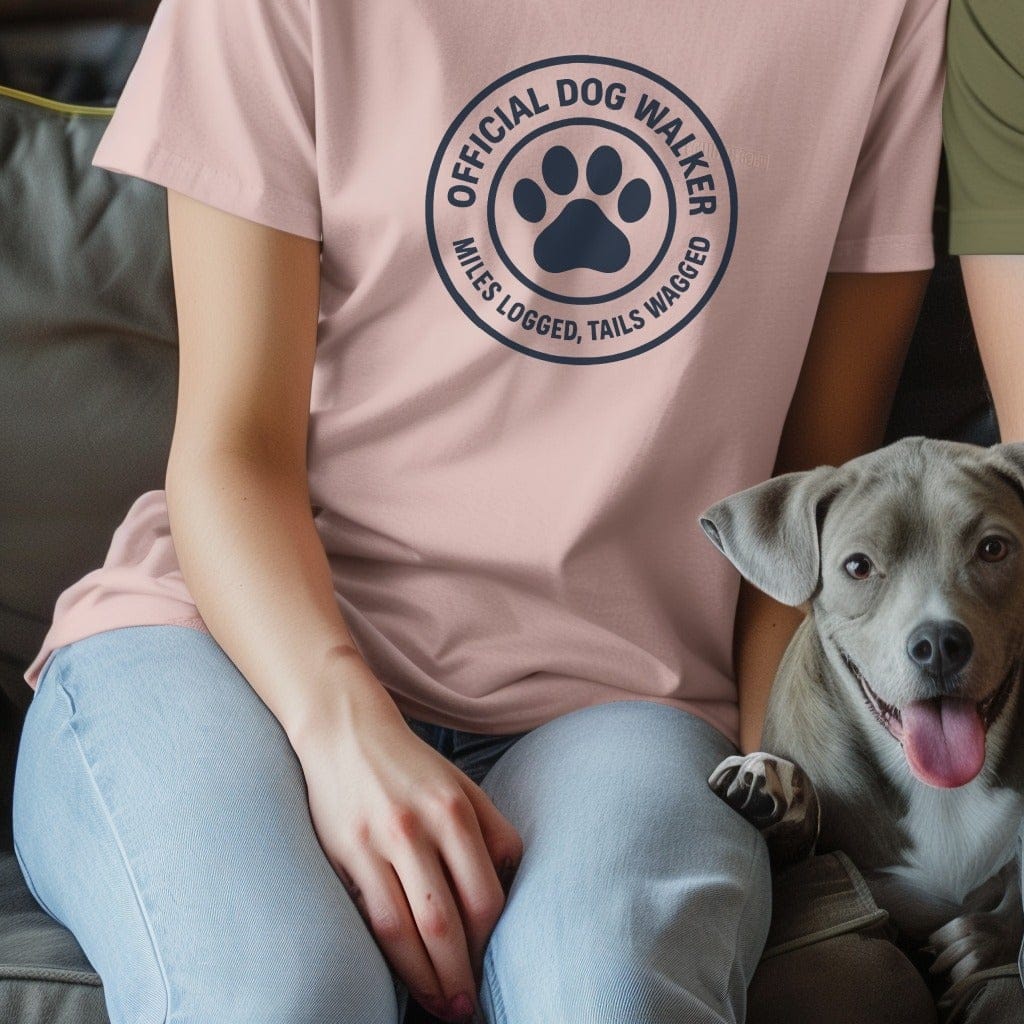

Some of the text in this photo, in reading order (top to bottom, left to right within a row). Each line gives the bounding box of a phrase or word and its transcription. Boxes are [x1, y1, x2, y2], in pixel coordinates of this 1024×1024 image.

[447, 77, 718, 216] OFFICIAL DOG WALKER
[452, 236, 711, 345] MILES LOGGED, TAILS WAGGED
